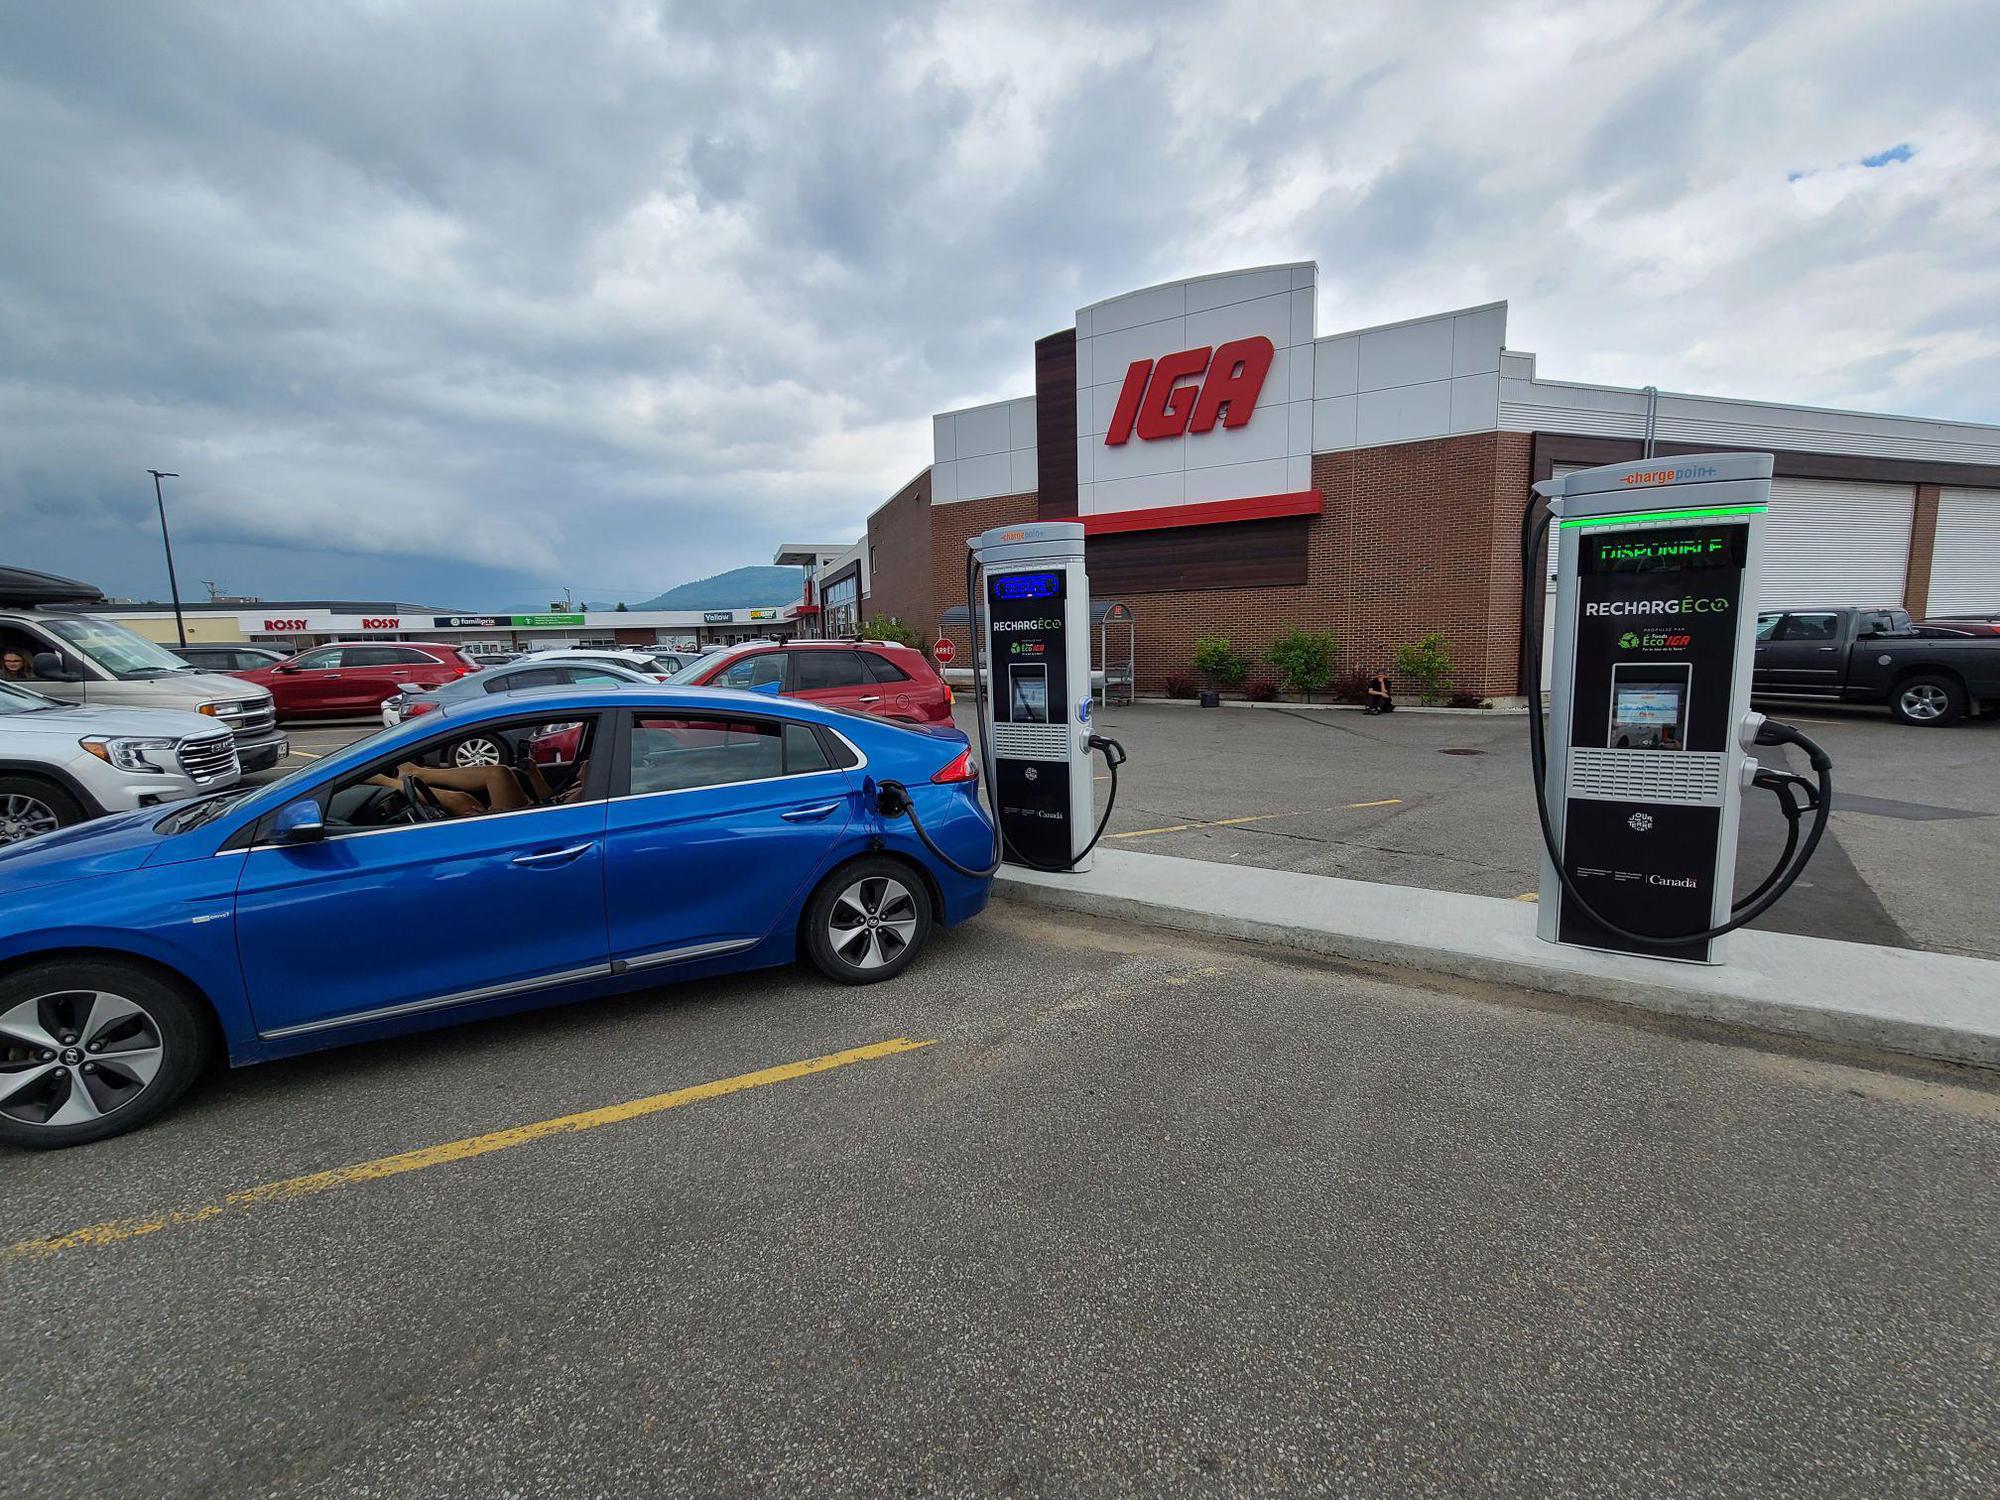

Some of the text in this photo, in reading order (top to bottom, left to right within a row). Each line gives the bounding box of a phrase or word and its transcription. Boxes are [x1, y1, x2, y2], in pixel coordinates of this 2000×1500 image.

[1105, 336, 1274, 446] IGA
[461, 617, 495, 626] familiprix
[705, 613, 729, 621] Yellow
[264, 620, 308, 631] ROSSY
[362, 618, 400, 629] ROSSY
[1665, 635, 1691, 646] IGA
[1649, 874, 1697, 889] Canada
